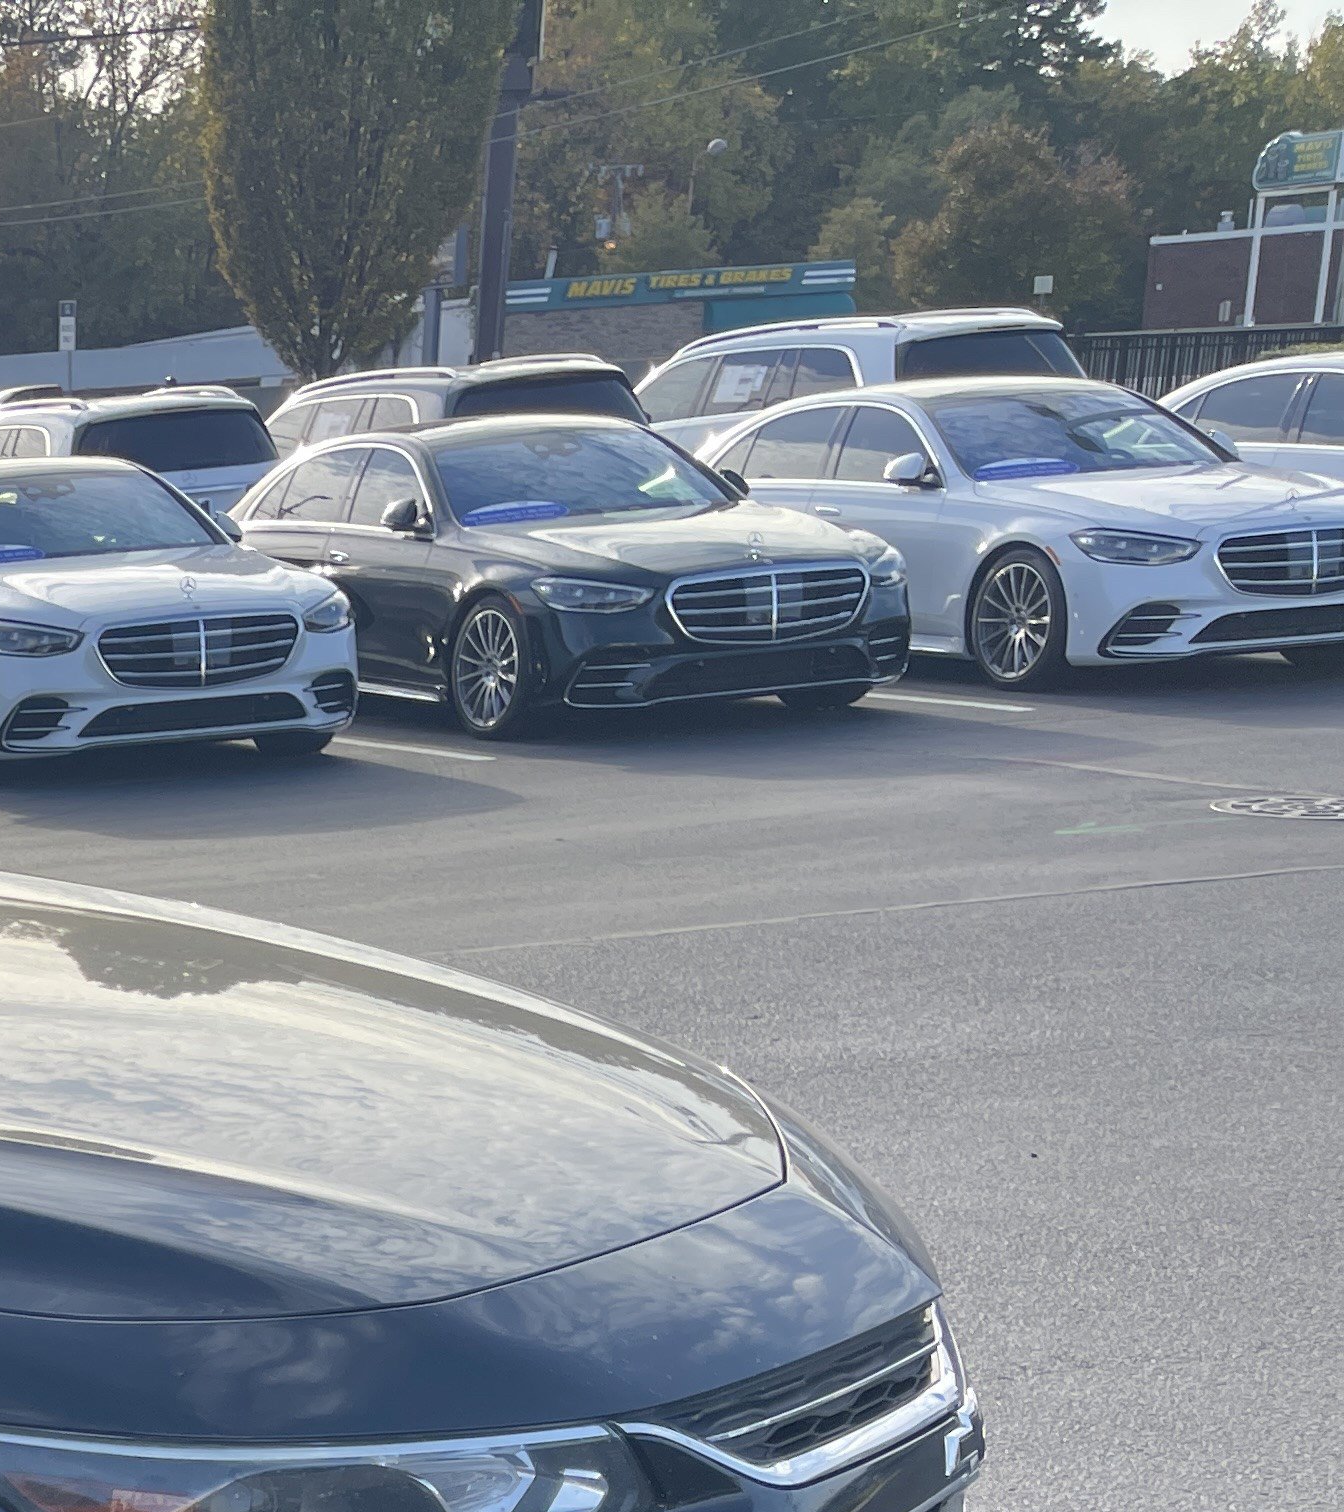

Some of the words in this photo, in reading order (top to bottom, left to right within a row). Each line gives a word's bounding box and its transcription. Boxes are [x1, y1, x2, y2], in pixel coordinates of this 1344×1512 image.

[567, 278, 637, 298] MAVIS
[650, 273, 700, 289] TIRES
[720, 268, 793, 284] BRAKES
